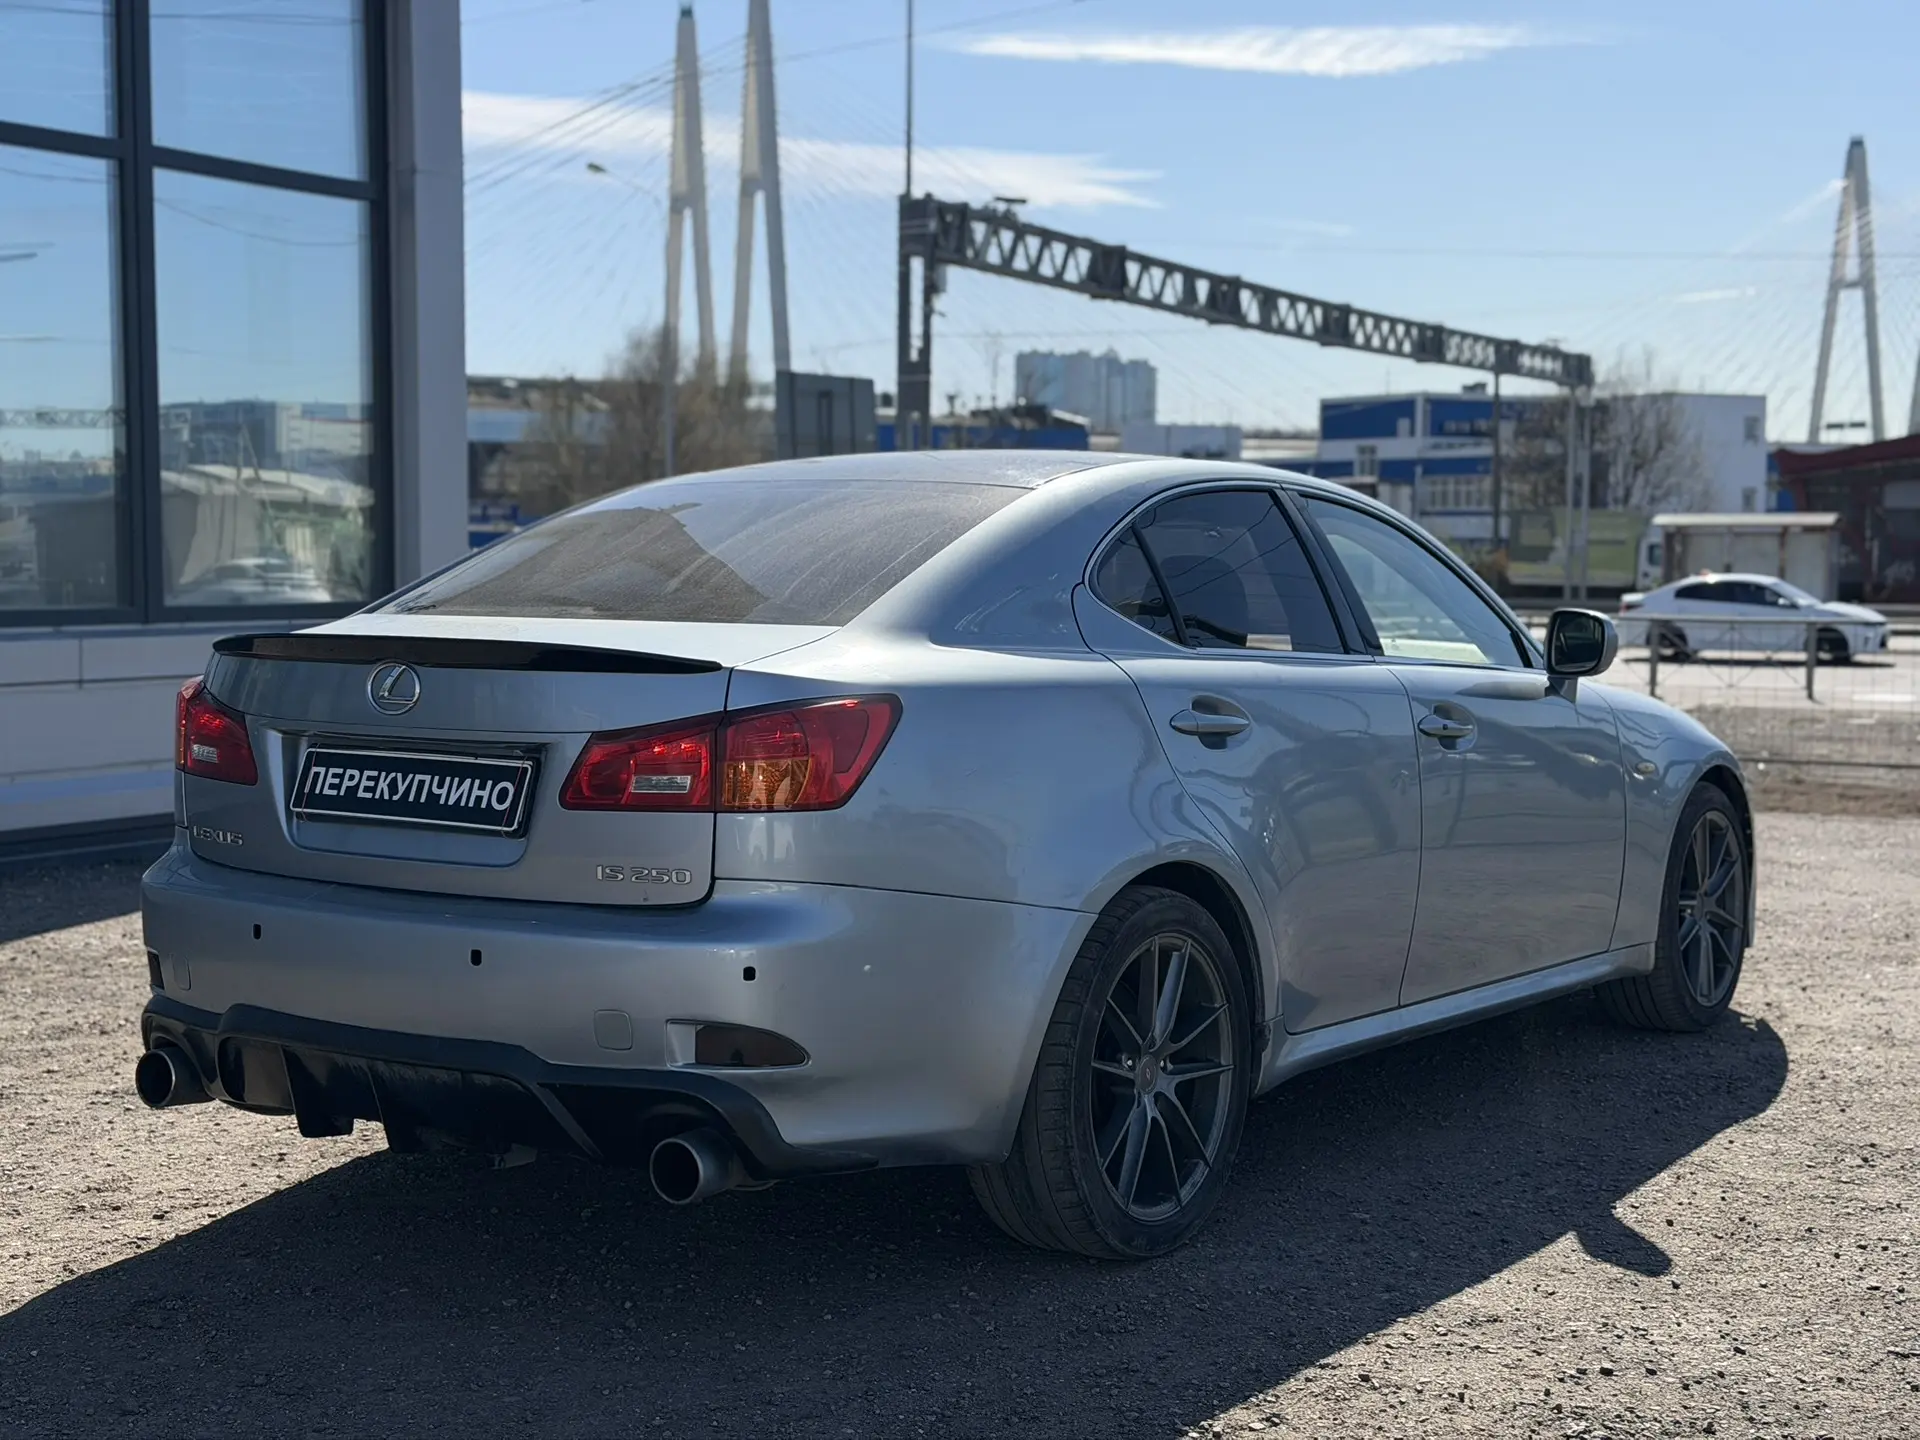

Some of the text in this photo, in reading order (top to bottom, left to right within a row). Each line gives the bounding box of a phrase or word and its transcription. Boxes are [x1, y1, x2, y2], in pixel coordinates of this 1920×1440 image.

[304, 766, 515, 811] ПЕРЕКУПЧИНО
[193, 825, 243, 846] LEXUS
[596, 864, 692, 885] IS 250
